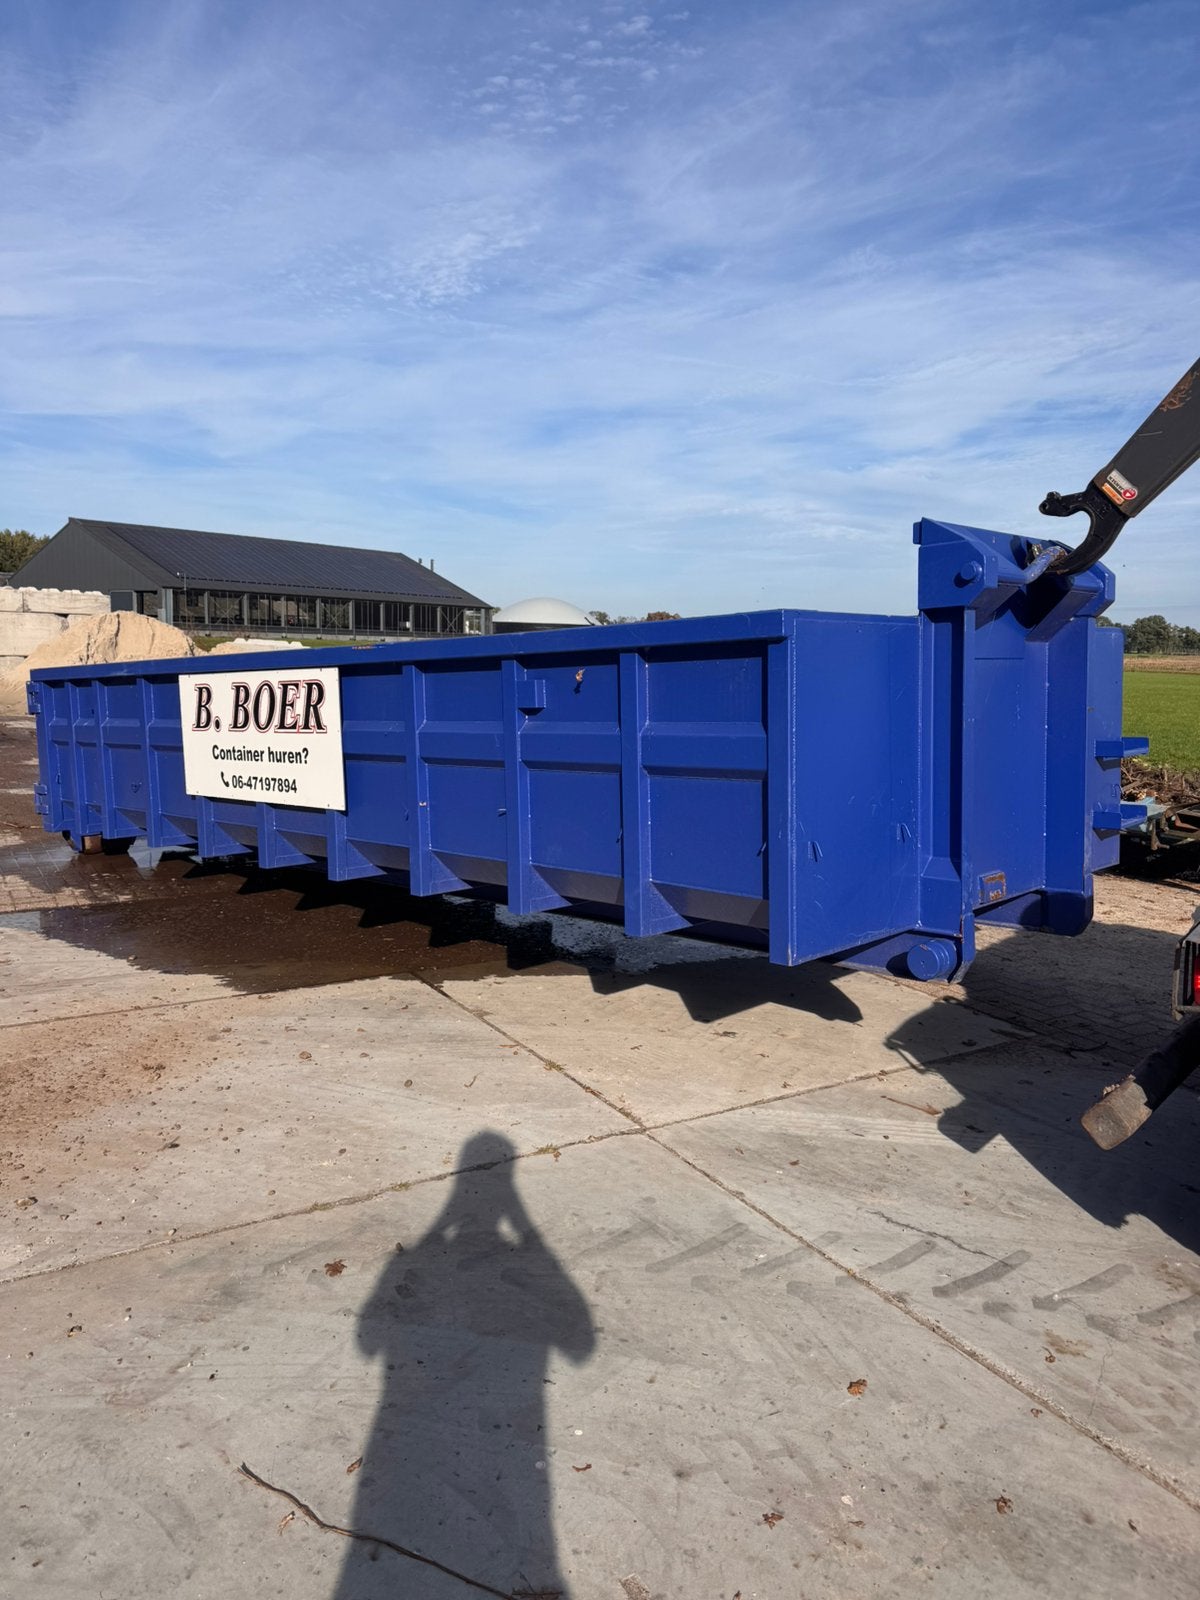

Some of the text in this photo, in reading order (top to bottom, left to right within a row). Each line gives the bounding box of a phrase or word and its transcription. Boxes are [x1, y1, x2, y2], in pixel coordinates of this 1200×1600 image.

[192, 679, 327, 734] B. BOER
[212, 744, 309, 764] Container huren?
[231, 774, 297, 793] 06-47197894
